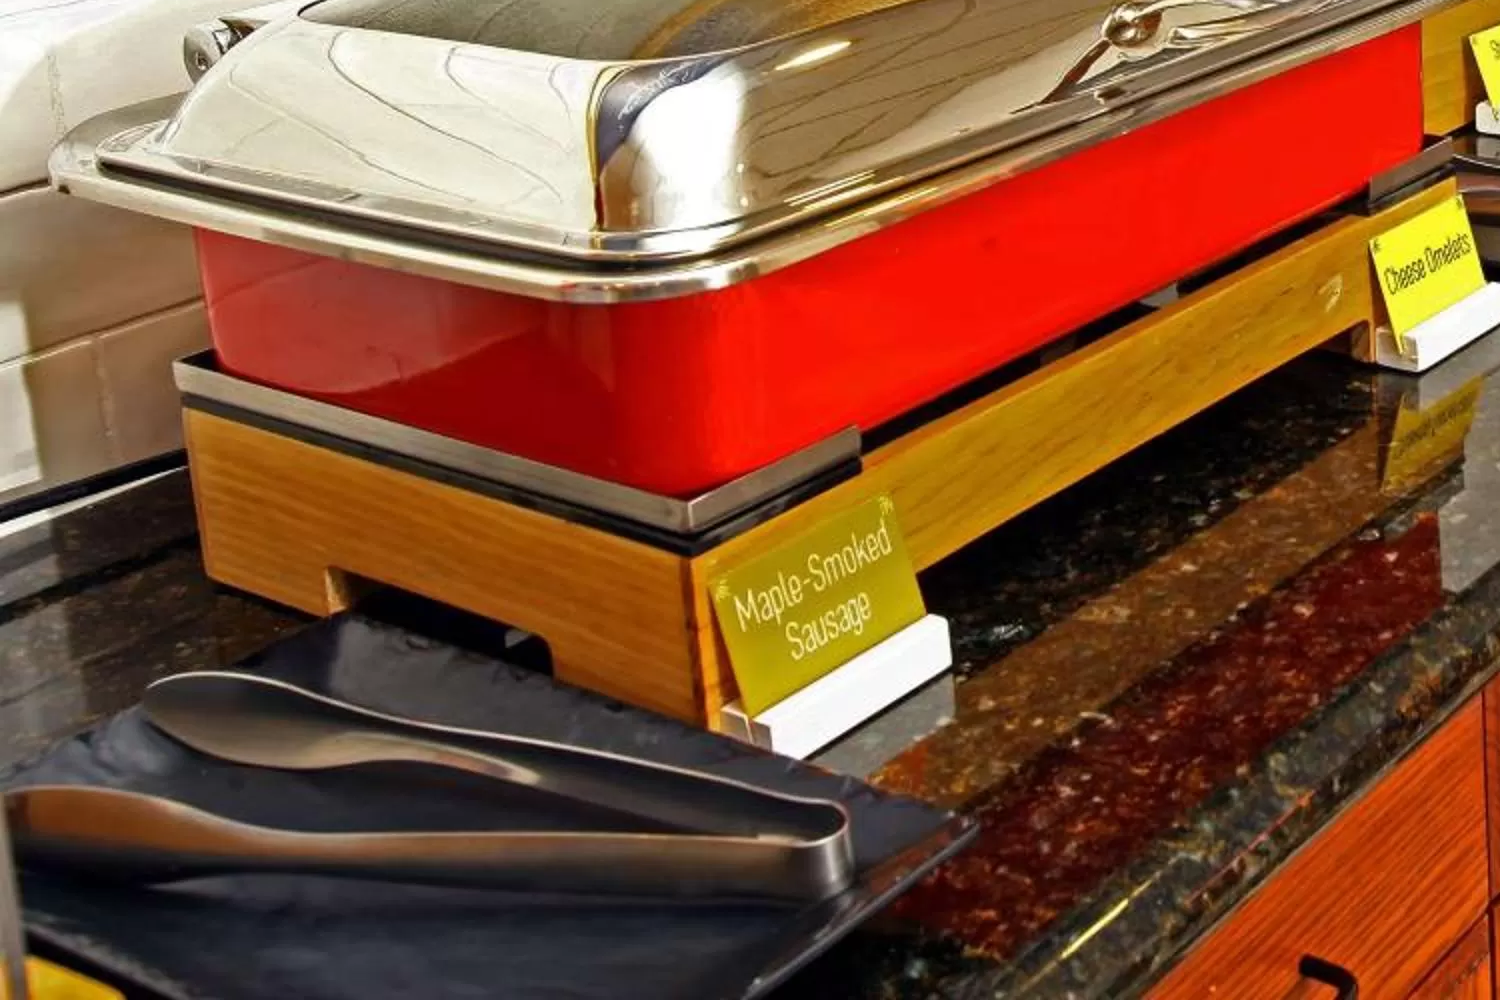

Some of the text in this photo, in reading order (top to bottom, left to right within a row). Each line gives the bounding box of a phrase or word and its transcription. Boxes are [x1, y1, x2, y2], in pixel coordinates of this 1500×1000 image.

[1384, 232, 1471, 296] Cheese Omelets
[733, 517, 893, 632] Maple-Smoked
[785, 591, 873, 661] Sausage
